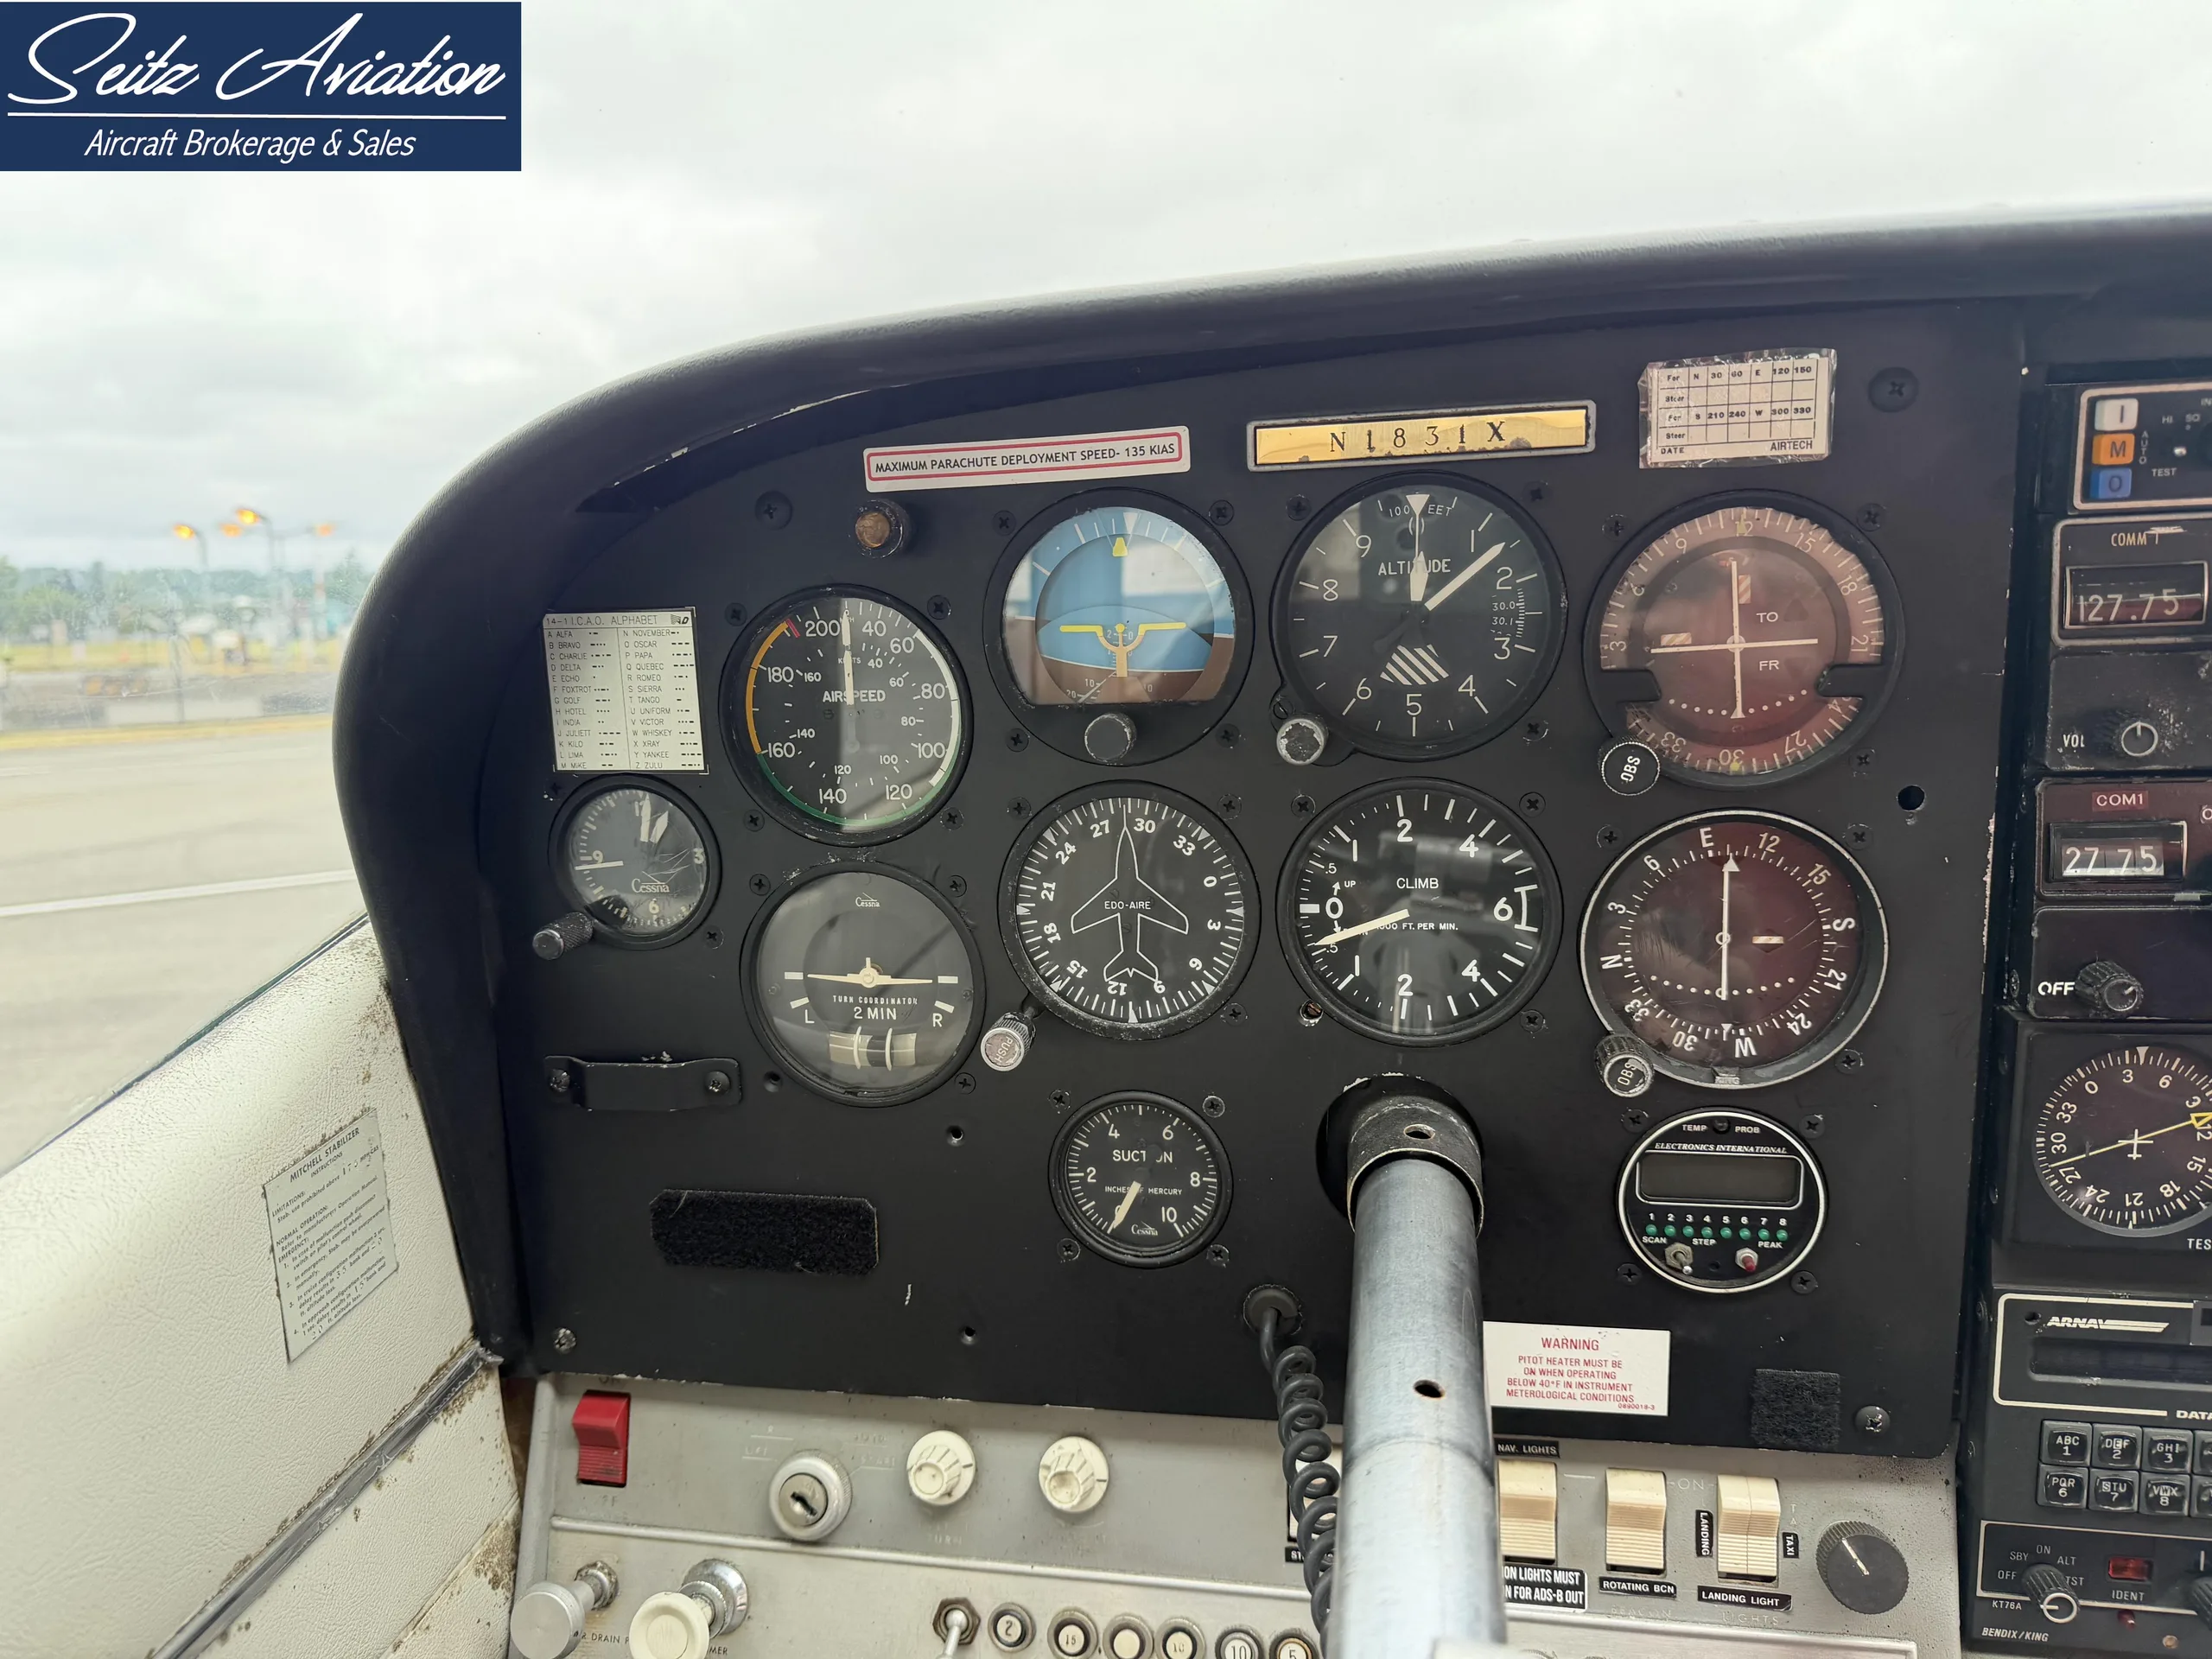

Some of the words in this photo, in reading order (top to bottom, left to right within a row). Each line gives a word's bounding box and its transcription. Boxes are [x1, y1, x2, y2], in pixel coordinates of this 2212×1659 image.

[1770, 440, 1813, 451] AIRTECH
[2110, 441, 2126, 458] M
[875, 459, 928, 474] MAXIMUM
[931, 455, 998, 470] PARACHUTE
[1001, 450, 1077, 466] DEPLOYMENT
[1080, 448, 1120, 461] SPEED-
[1124, 446, 1147, 457] 135
[1149, 443, 1175, 456] KIAS
[2152, 468, 2177, 477] TEST
[1356, 535, 1371, 557] 9
[2111, 532, 2147, 547] COMM
[1378, 559, 1451, 575] ALTIUDE
[1497, 566, 1513, 590] 2
[1323, 579, 1338, 601] 8
[571, 616, 604, 626] I.C.A.O.
[611, 615, 658, 625] ALPHABET
[1756, 612, 1778, 623] TO
[805, 620, 840, 638] 200
[862, 620, 887, 636] 40
[890, 638, 914, 653] 60
[1323, 635, 1338, 658] 7
[1494, 637, 1510, 660] 3
[1759, 660, 1779, 671] FR
[767, 666, 794, 683] 180
[921, 683, 945, 698] 80
[1357, 677, 1372, 700] 6
[1458, 674, 1476, 696] 4
[1406, 694, 1422, 715] 5
[2063, 734, 2085, 748] VOL
[768, 742, 795, 758] 160
[918, 742, 945, 759] 100
[1620, 755, 1641, 782] OBS
[819, 788, 847, 804] 140
[886, 785, 912, 800] 120
[2096, 793, 2144, 806] COM1
[1090, 820, 1110, 837] 27
[1134, 818, 1156, 834] 30
[1397, 819, 1413, 842] 2
[1173, 835, 1196, 856] 33
[1459, 834, 1478, 857] 4
[1700, 828, 1714, 848] E
[1758, 832, 1780, 853] 12
[632, 879, 670, 893] Cessna
[1396, 878, 1439, 889] CLIMB
[855, 897, 880, 906] Cessna
[1104, 900, 1151, 910] EDO-AIRE
[1325, 897, 1343, 919] 0
[1493, 897, 1513, 922] 6
[2037, 982, 2075, 995] OFF
[859, 996, 918, 1005] COORDINATOR
[804, 1009, 815, 1023] L
[854, 1007, 863, 1019] 2
[868, 1007, 897, 1020] MIN
[933, 1014, 943, 1027] R
[995, 1036, 1014, 1063] PUSH
[1109, 1124, 1120, 1138] 4
[1163, 1125, 1173, 1140] 6
[289, 1154, 322, 1183] MITCHELL
[325, 1127, 359, 1157] STABILIZER
[1716, 1144, 1787, 1154] INTERNATIONAL
[311, 1151, 343, 1178] INSTRUCTIONS
[1190, 1172, 1200, 1187] 8
[1161, 1206, 1177, 1223] 10
[1131, 1224, 1158, 1236] Cessna
[2047, 1316, 2107, 1329] ARNAV
[1541, 1338, 1599, 1351] WARNING
[1518, 1356, 1543, 1364] PITOT
[1547, 1357, 1580, 1366] HEATER
[1583, 1358, 1607, 1368] MUST
[1611, 1360, 1623, 1369] BE
[1539, 1368, 1563, 1376] WHEN
[1567, 1370, 1617, 1379] OPERATING
[1507, 1378, 1536, 1387] BELOW
[1575, 1382, 1632, 1392] INSTRUMENT
[1506, 1389, 1577, 1401] METEROLOGICAL
[1580, 1393, 1634, 1402] CONDITIONS
[2056, 1435, 2080, 1446] ABC
[2106, 1439, 2130, 1449] DEF
[1497, 1443, 1518, 1452] NAV.
[1522, 1446, 1556, 1454] LIGHTS
[2052, 1478, 2075, 1488] PQR
[2102, 1482, 2127, 1492] STU
[2153, 1485, 2178, 1497] VWX
[1700, 1512, 1710, 1555] LANDING
[1786, 1535, 1795, 1555] TAXI
[2037, 1544, 2051, 1554] ON
[2010, 1552, 2029, 1561] SBY
[2057, 1556, 2076, 1566] ALT
[1519, 1567, 1552, 1582] LIGHTS
[1554, 1571, 1580, 1585] MUST
[1998, 1570, 2017, 1580] OFF
[1603, 1580, 1649, 1592] ROTATING
[1654, 1585, 1675, 1594] BCN
[1514, 1587, 1532, 1600] FOR
[1534, 1589, 1563, 1602] ADS-B
[1566, 1591, 1585, 1604] OUT
[1702, 1591, 1745, 1603] LANDING
[1751, 1597, 1780, 1606] LIGHT
[2112, 1590, 2145, 1602] IDENT
[1993, 1600, 2022, 1611] KT76A
[1982, 1627, 2049, 1642] BENDIX/KING
